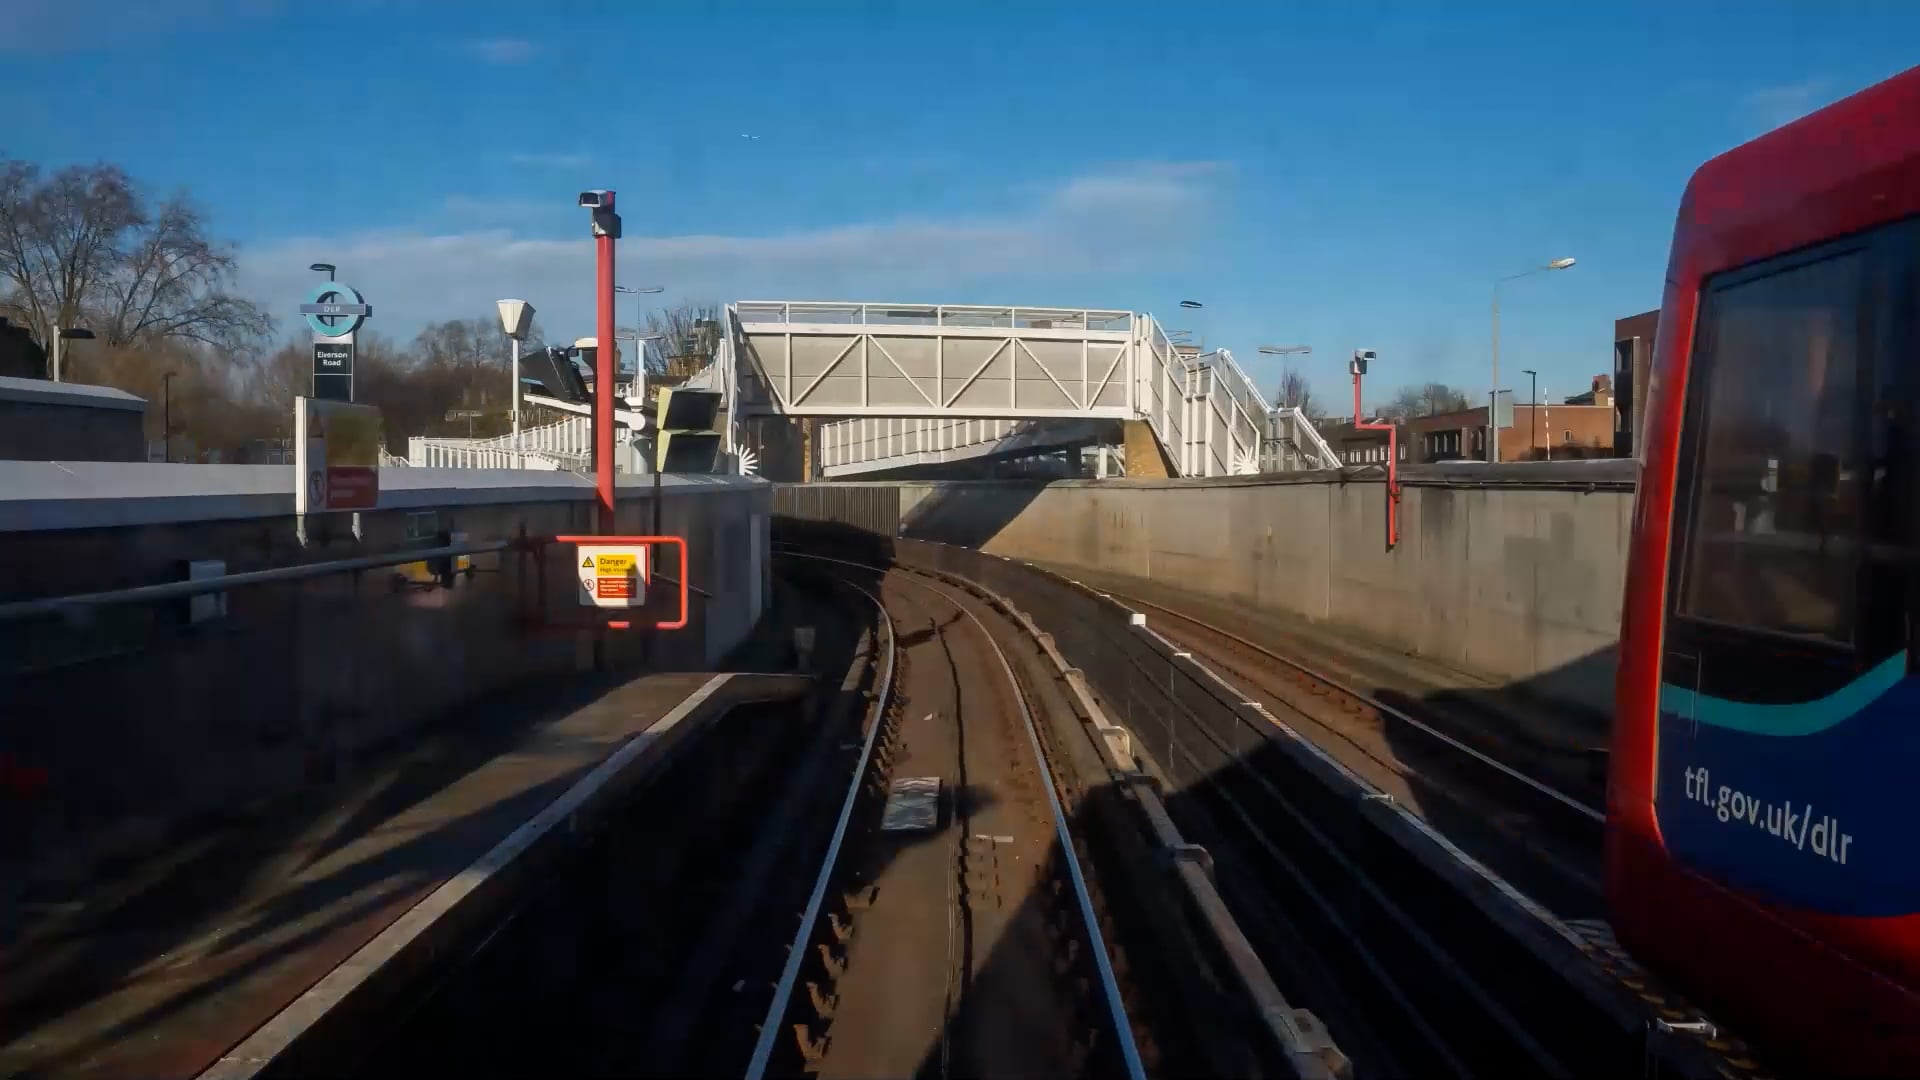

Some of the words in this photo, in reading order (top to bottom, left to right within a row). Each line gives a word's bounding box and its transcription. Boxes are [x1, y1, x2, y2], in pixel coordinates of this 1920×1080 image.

[323, 305, 341, 313] DLR
[317, 351, 348, 359] Elverson
[599, 558, 628, 566] Danger
[1685, 766, 1852, 864] tfl.gov.uk/dlr
